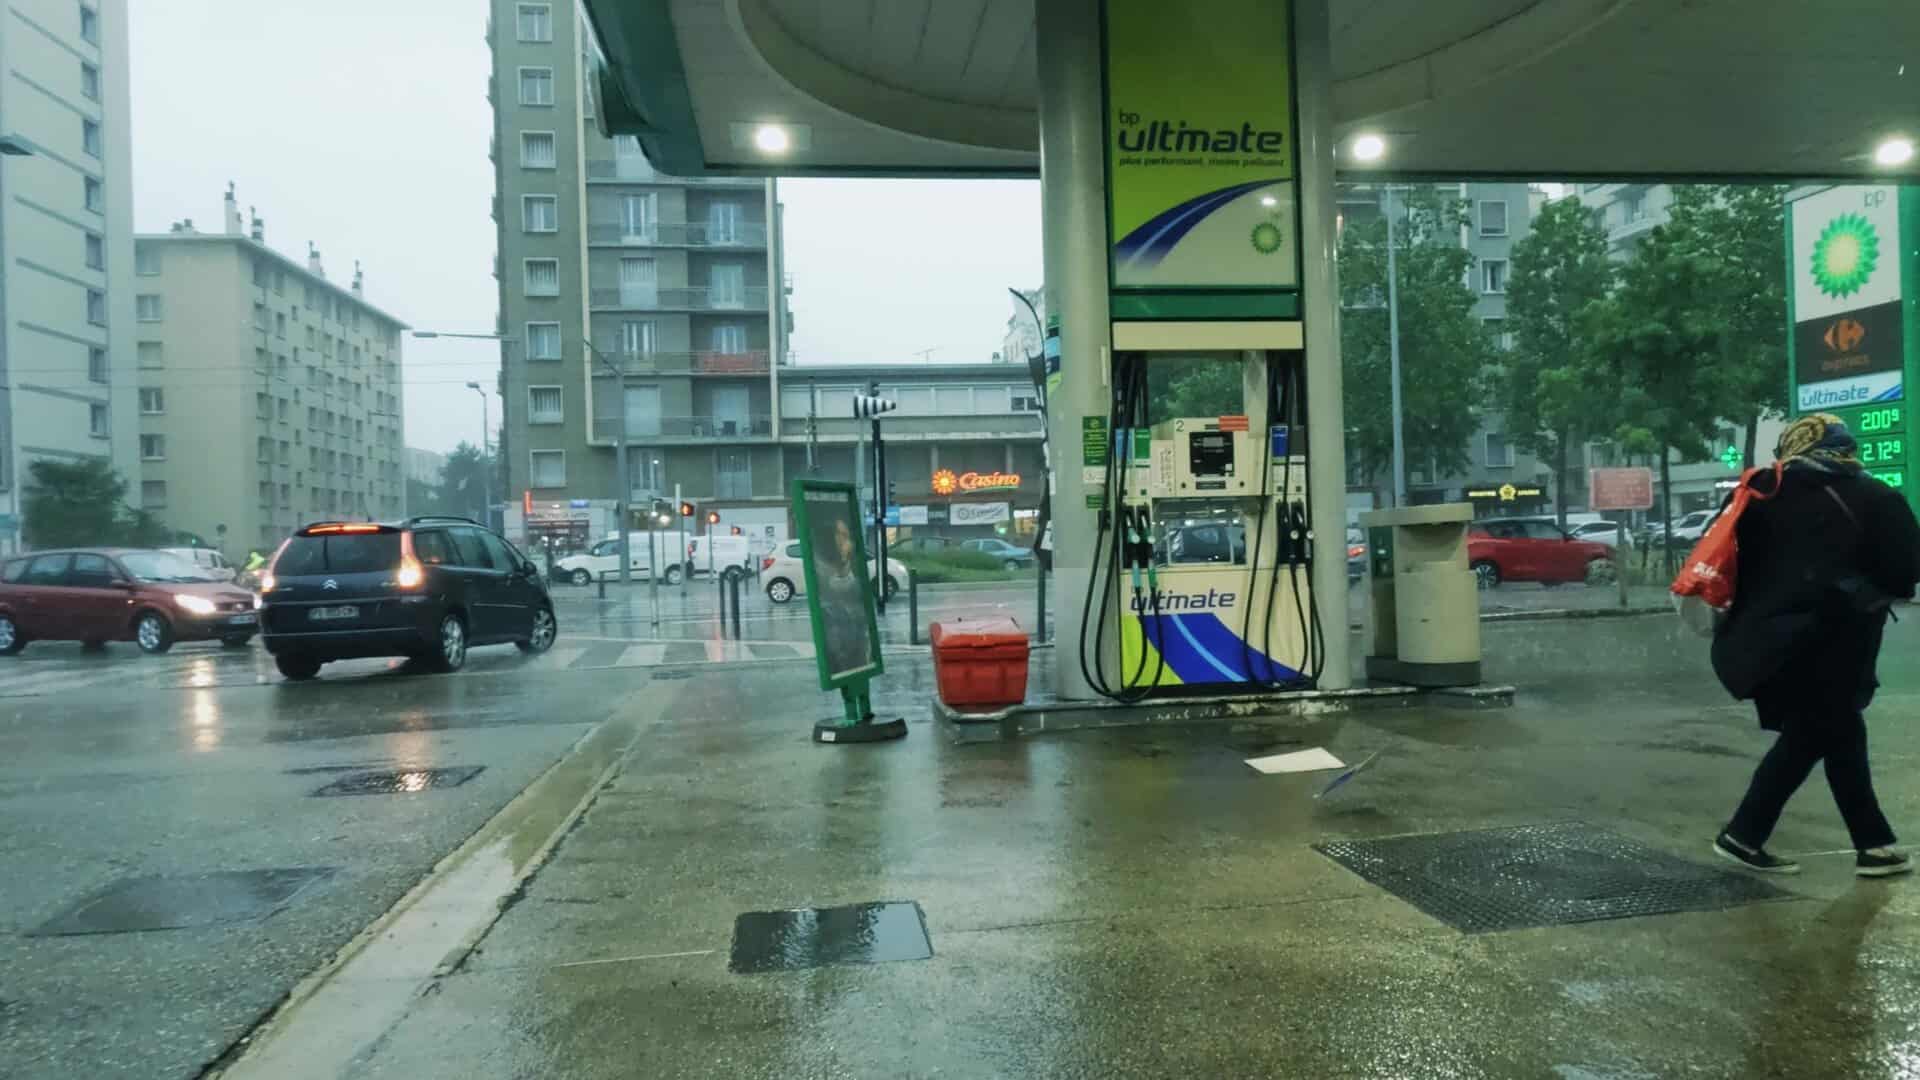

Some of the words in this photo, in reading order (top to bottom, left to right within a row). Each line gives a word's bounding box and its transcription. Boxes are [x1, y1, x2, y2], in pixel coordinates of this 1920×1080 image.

[1119, 109, 1140, 127] bp
[1119, 120, 1283, 153] ultimate
[1802, 384, 1869, 407] ultimate
[1175, 419, 1185, 432] 2
[959, 472, 1021, 490] Casino
